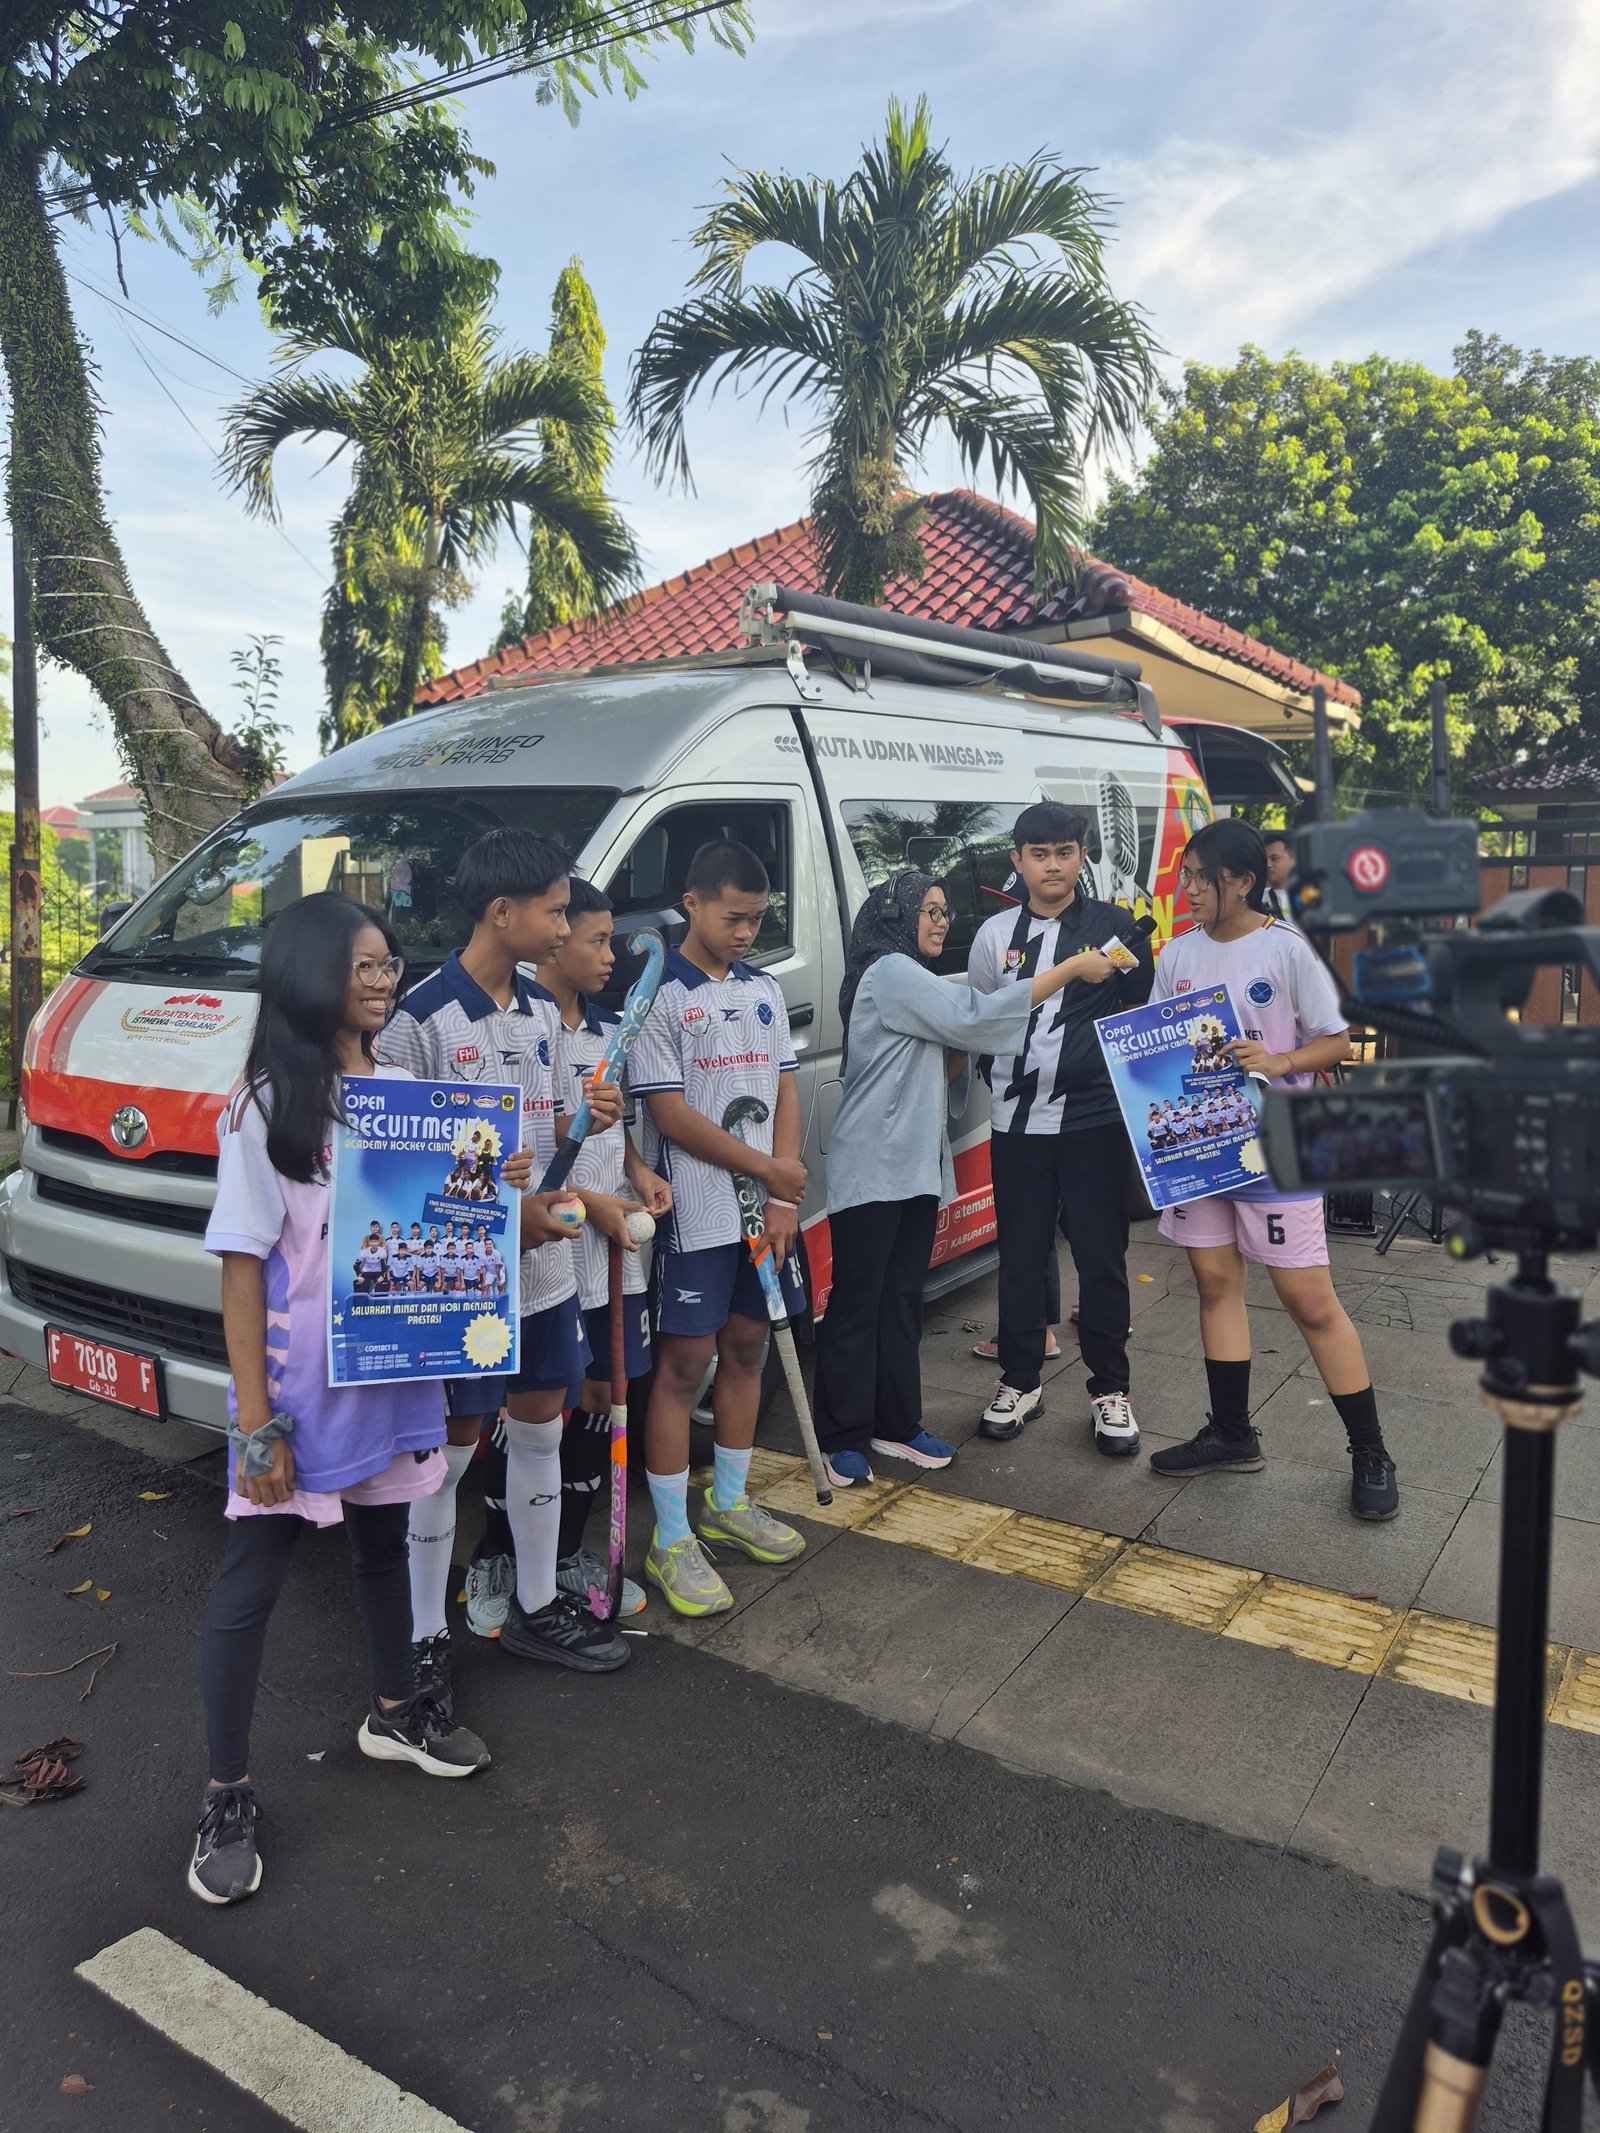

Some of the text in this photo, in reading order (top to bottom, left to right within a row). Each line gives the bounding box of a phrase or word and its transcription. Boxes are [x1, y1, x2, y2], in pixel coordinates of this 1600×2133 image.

[811, 736, 987, 766] KUTA UDAYA WANGSA
[138, 1009, 224, 1022] KABUPATEN BOGOR
[685, 1008, 703, 1021] FHI
[132, 1017, 168, 1026] ISTIMEWA
[174, 1020, 217, 1030] GEMILANG
[1105, 1023, 1132, 1040] OPEN
[459, 1047, 477, 1061] FHI
[1113, 1051, 1142, 1065] ACADEMY
[1143, 1044, 1169, 1058] HOCKEY
[345, 1094, 385, 1111] OPEN
[344, 1139, 388, 1151] ACADEMY
[390, 1140, 425, 1152] HOCKEY
[1155, 1130, 1256, 1165] SALURKAN MINAT DAN HOBI MENJADI
[1196, 1150, 1221, 1161] PRESTASI
[951, 1220, 997, 1248] KABUPATEN
[1267, 1213, 1286, 1246] 6
[352, 1302, 496, 1316] SALURKAN MINAT DAN HOBI MENJADI
[407, 1314, 441, 1325] PRESTASI
[641, 1308, 651, 1348] 9
[365, 1344, 391, 1352] CONTACT
[51, 1334, 151, 1393] F 7018 F
